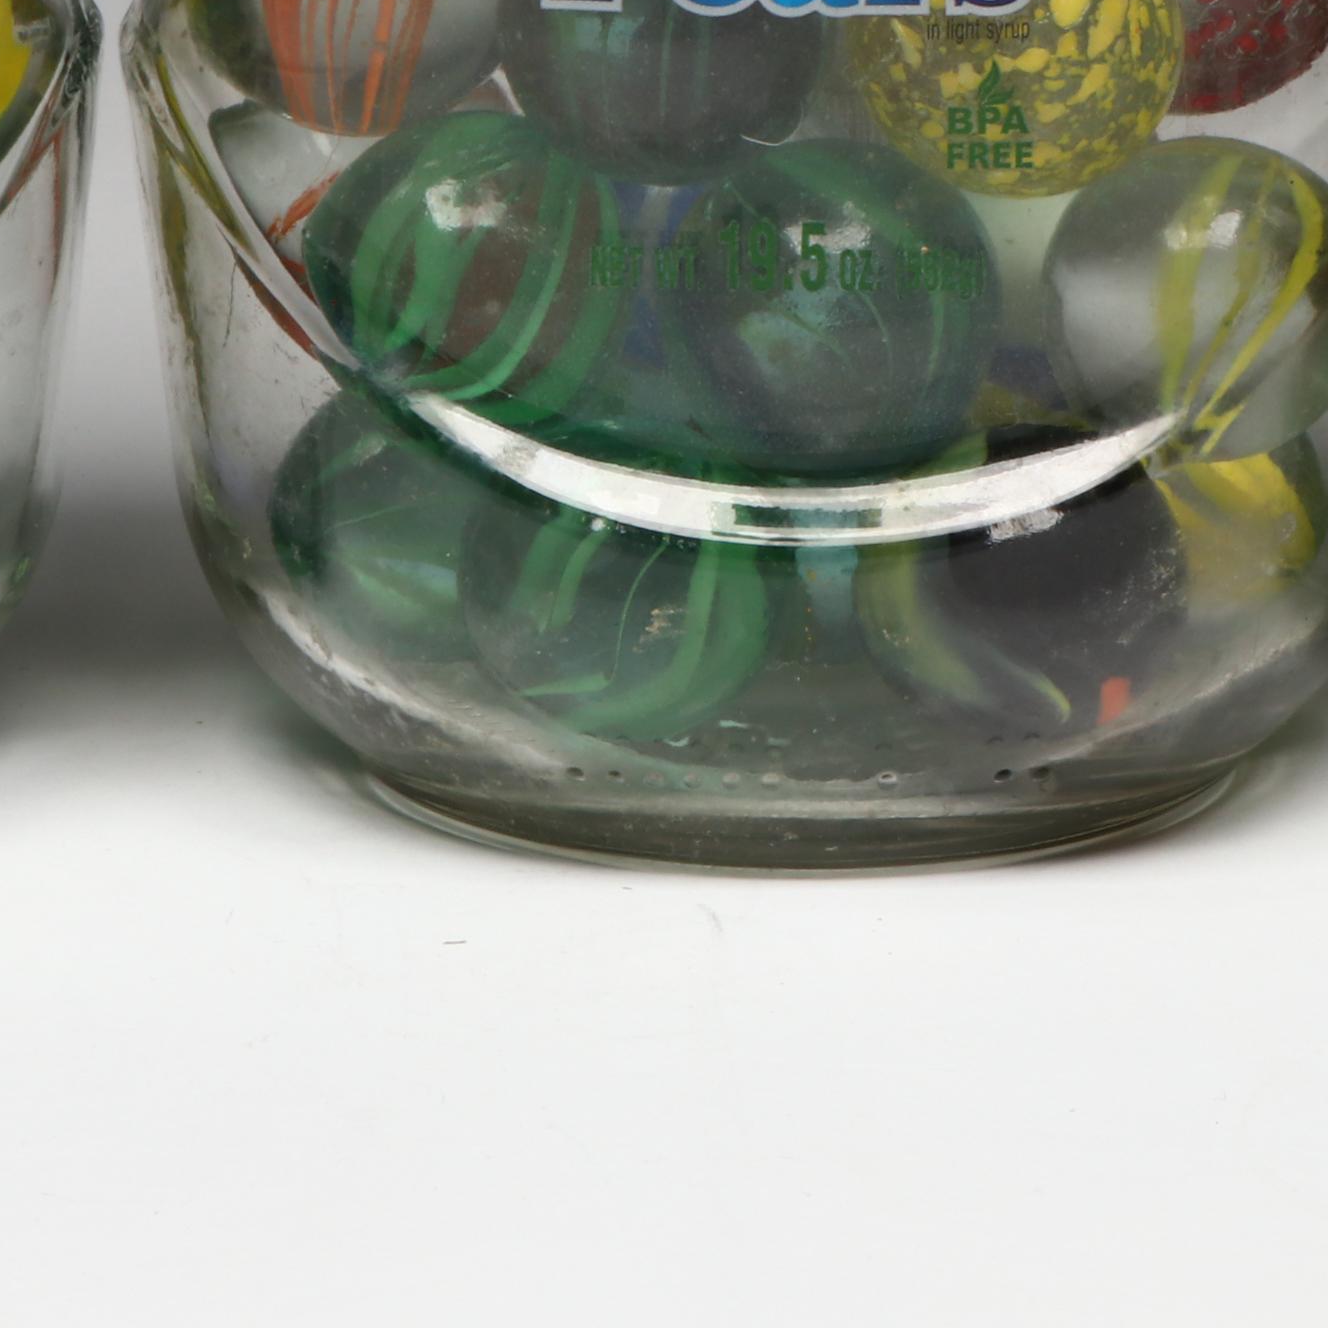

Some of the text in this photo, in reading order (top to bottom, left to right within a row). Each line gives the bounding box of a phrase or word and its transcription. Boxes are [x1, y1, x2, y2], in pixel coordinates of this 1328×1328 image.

[926, 20, 1031, 44] in light syrup
[947, 105, 1030, 134] BPA
[946, 140, 1034, 169] FREE
[718, 218, 829, 293] 19.5
